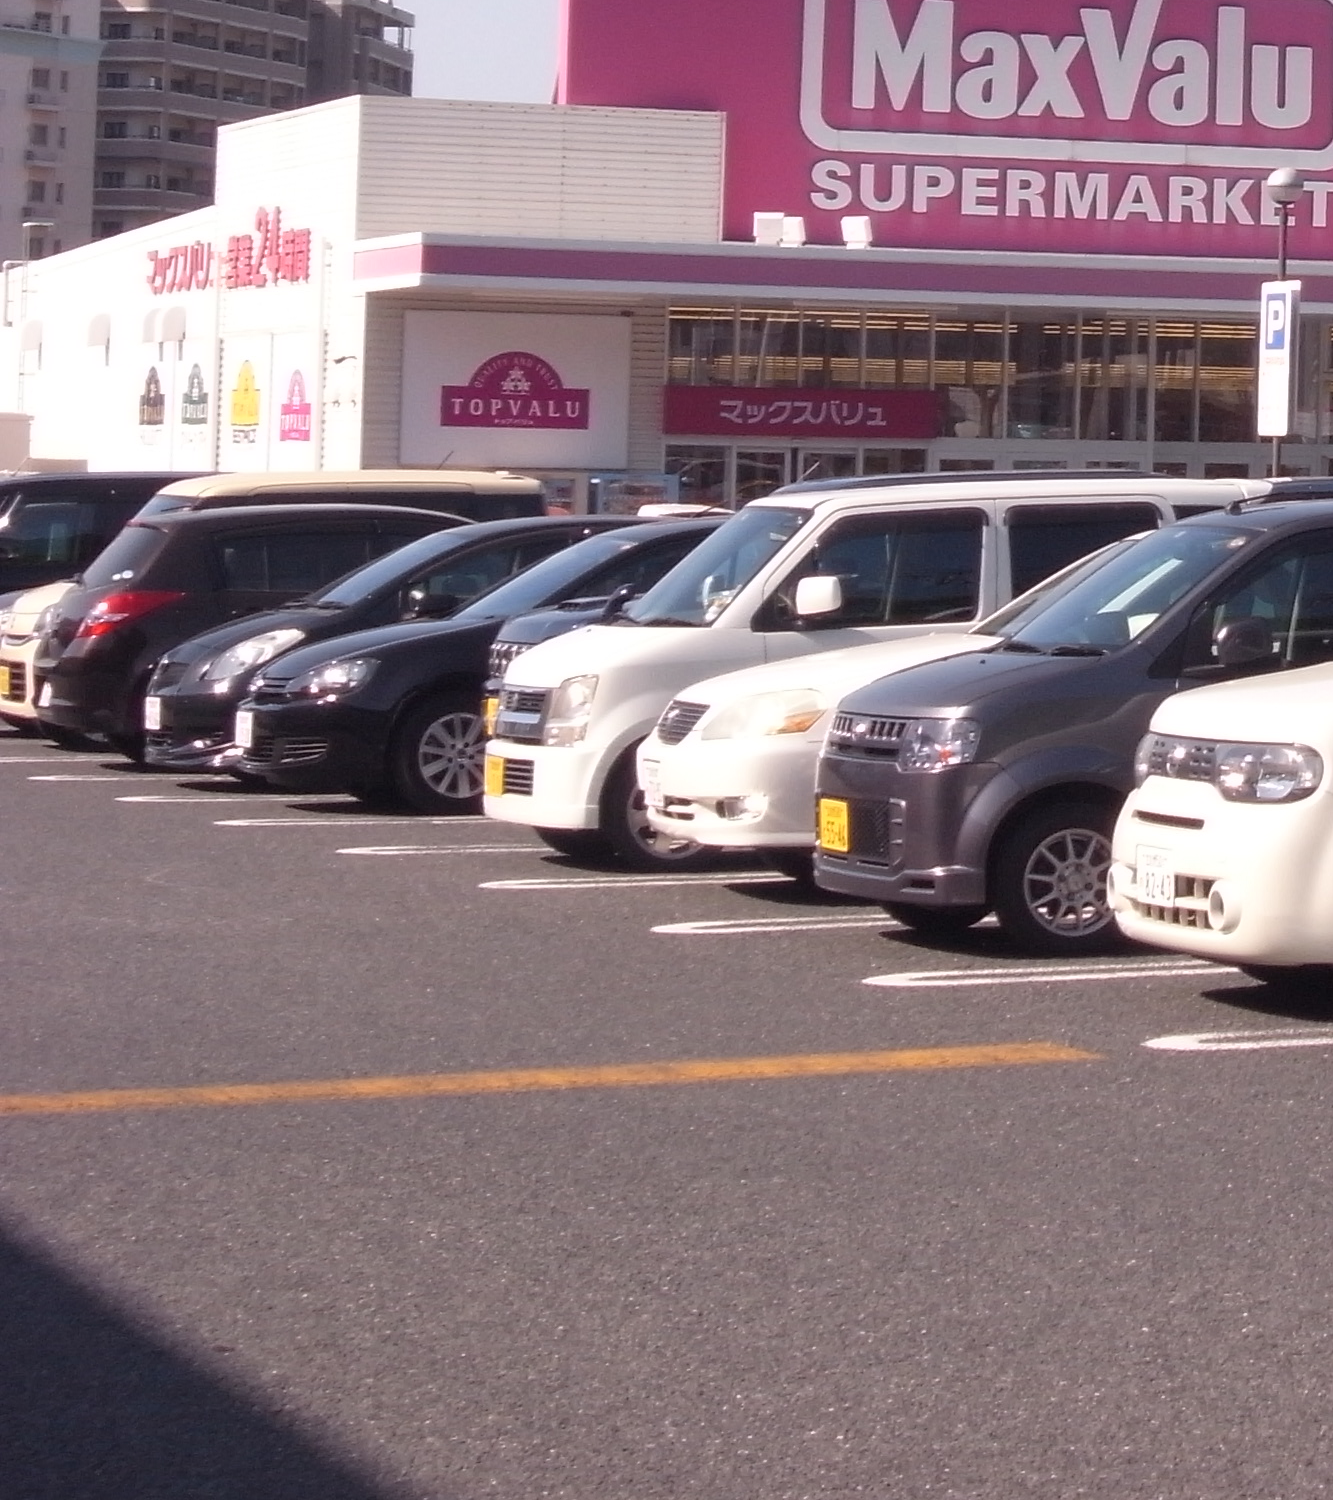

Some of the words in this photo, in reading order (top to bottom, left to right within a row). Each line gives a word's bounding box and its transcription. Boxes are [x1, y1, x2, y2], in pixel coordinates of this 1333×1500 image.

[1267, 300, 1284, 344] P
[514, 357, 533, 367] AND
[451, 399, 580, 418] TOPVALU
[720, 400, 886, 426] マックスバリュ
